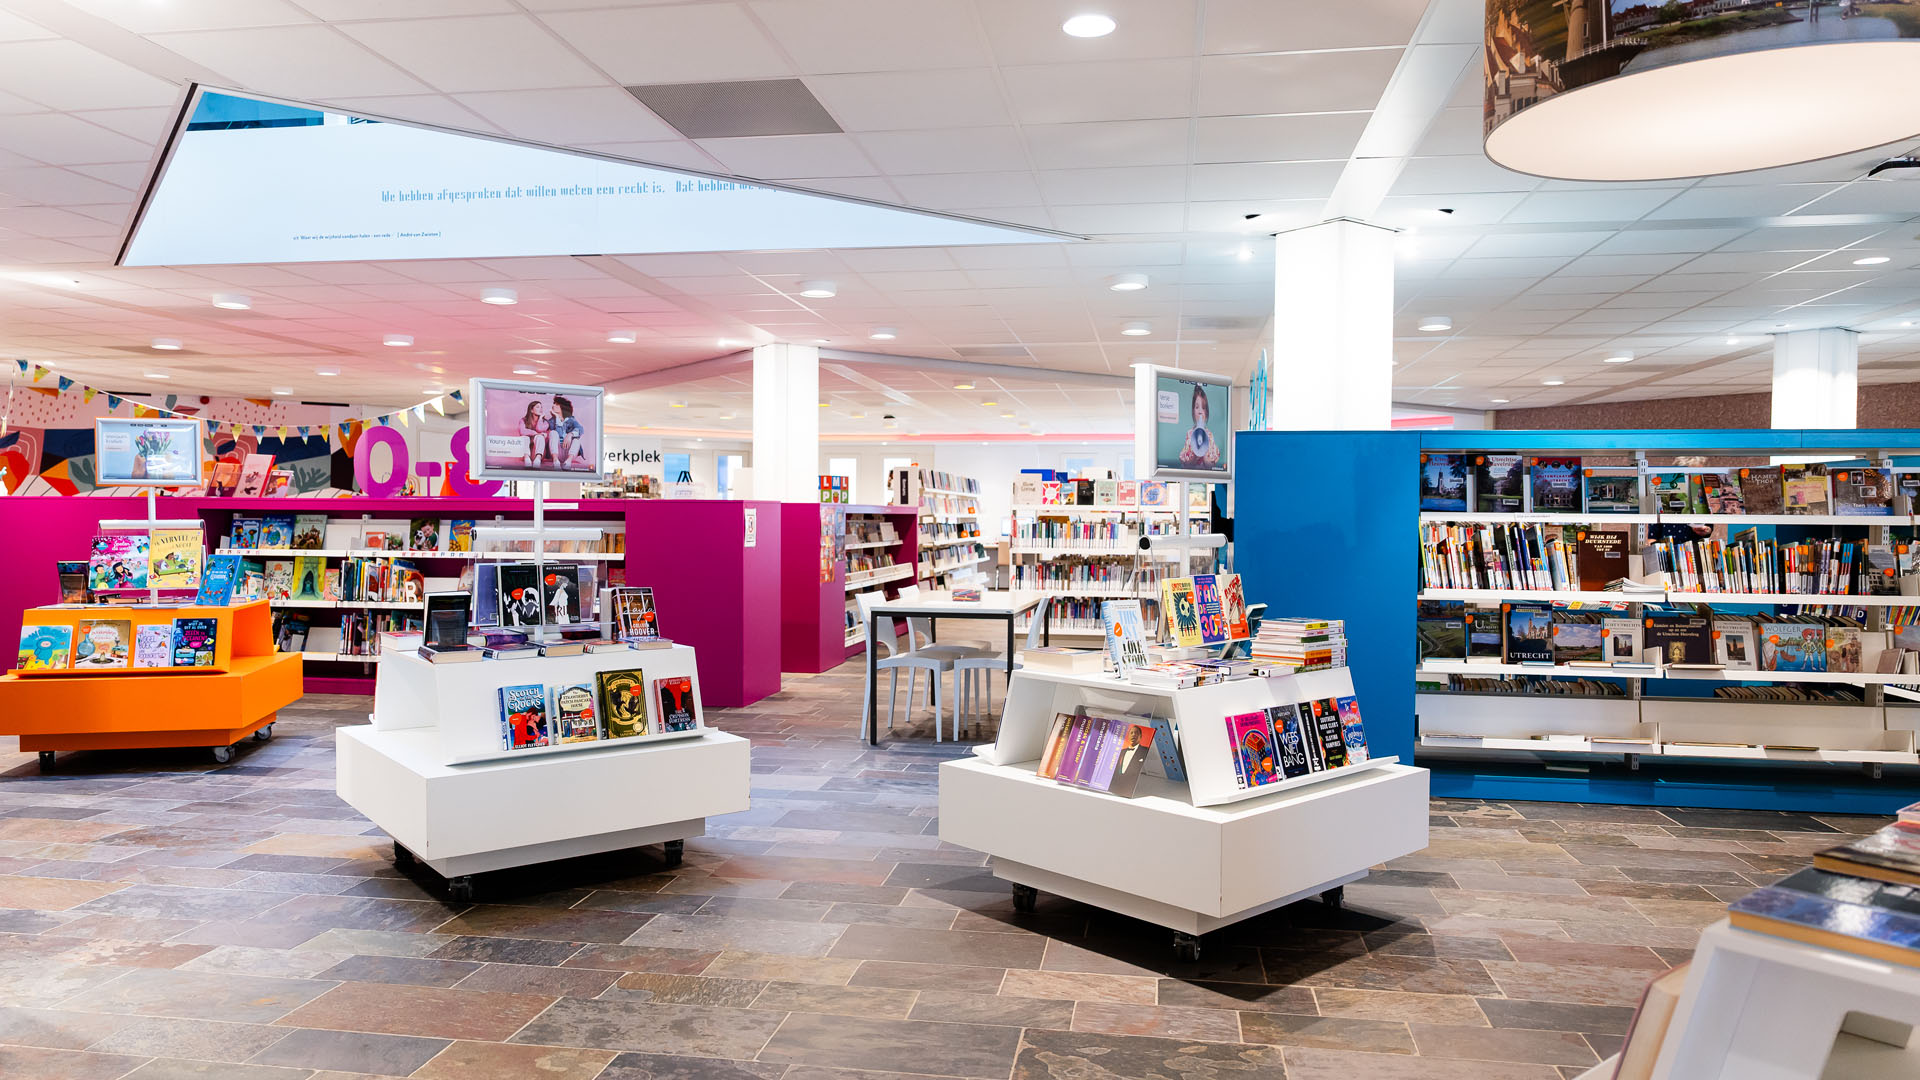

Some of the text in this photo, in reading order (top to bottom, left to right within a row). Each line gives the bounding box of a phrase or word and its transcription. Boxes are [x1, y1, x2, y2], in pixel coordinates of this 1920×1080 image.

[381, 190, 396, 202] We
[399, 189, 434, 202] hebben
[436, 187, 501, 204] afgesproken
[505, 186, 522, 199] dat
[526, 185, 557, 198] willen
[560, 184, 593, 196] weten
[596, 186, 614, 195] een
[618, 181, 649, 194] recht
[652, 180, 665, 193] is.
[675, 179, 694, 193] Dat
[697, 178, 735, 192] hebben
[489, 438, 506, 446] Young
[1751, 473, 1777, 481] HAMER
[629, 627, 655, 636] HOOVER
[1765, 624, 1801, 633] WOLFGER
[1510, 652, 1551, 660] UTRECHT
[509, 687, 543, 699] SCOTCH
[508, 699, 541, 712] ROCKS
[1279, 732, 1299, 746] WEES
[1283, 752, 1305, 768] BANG
